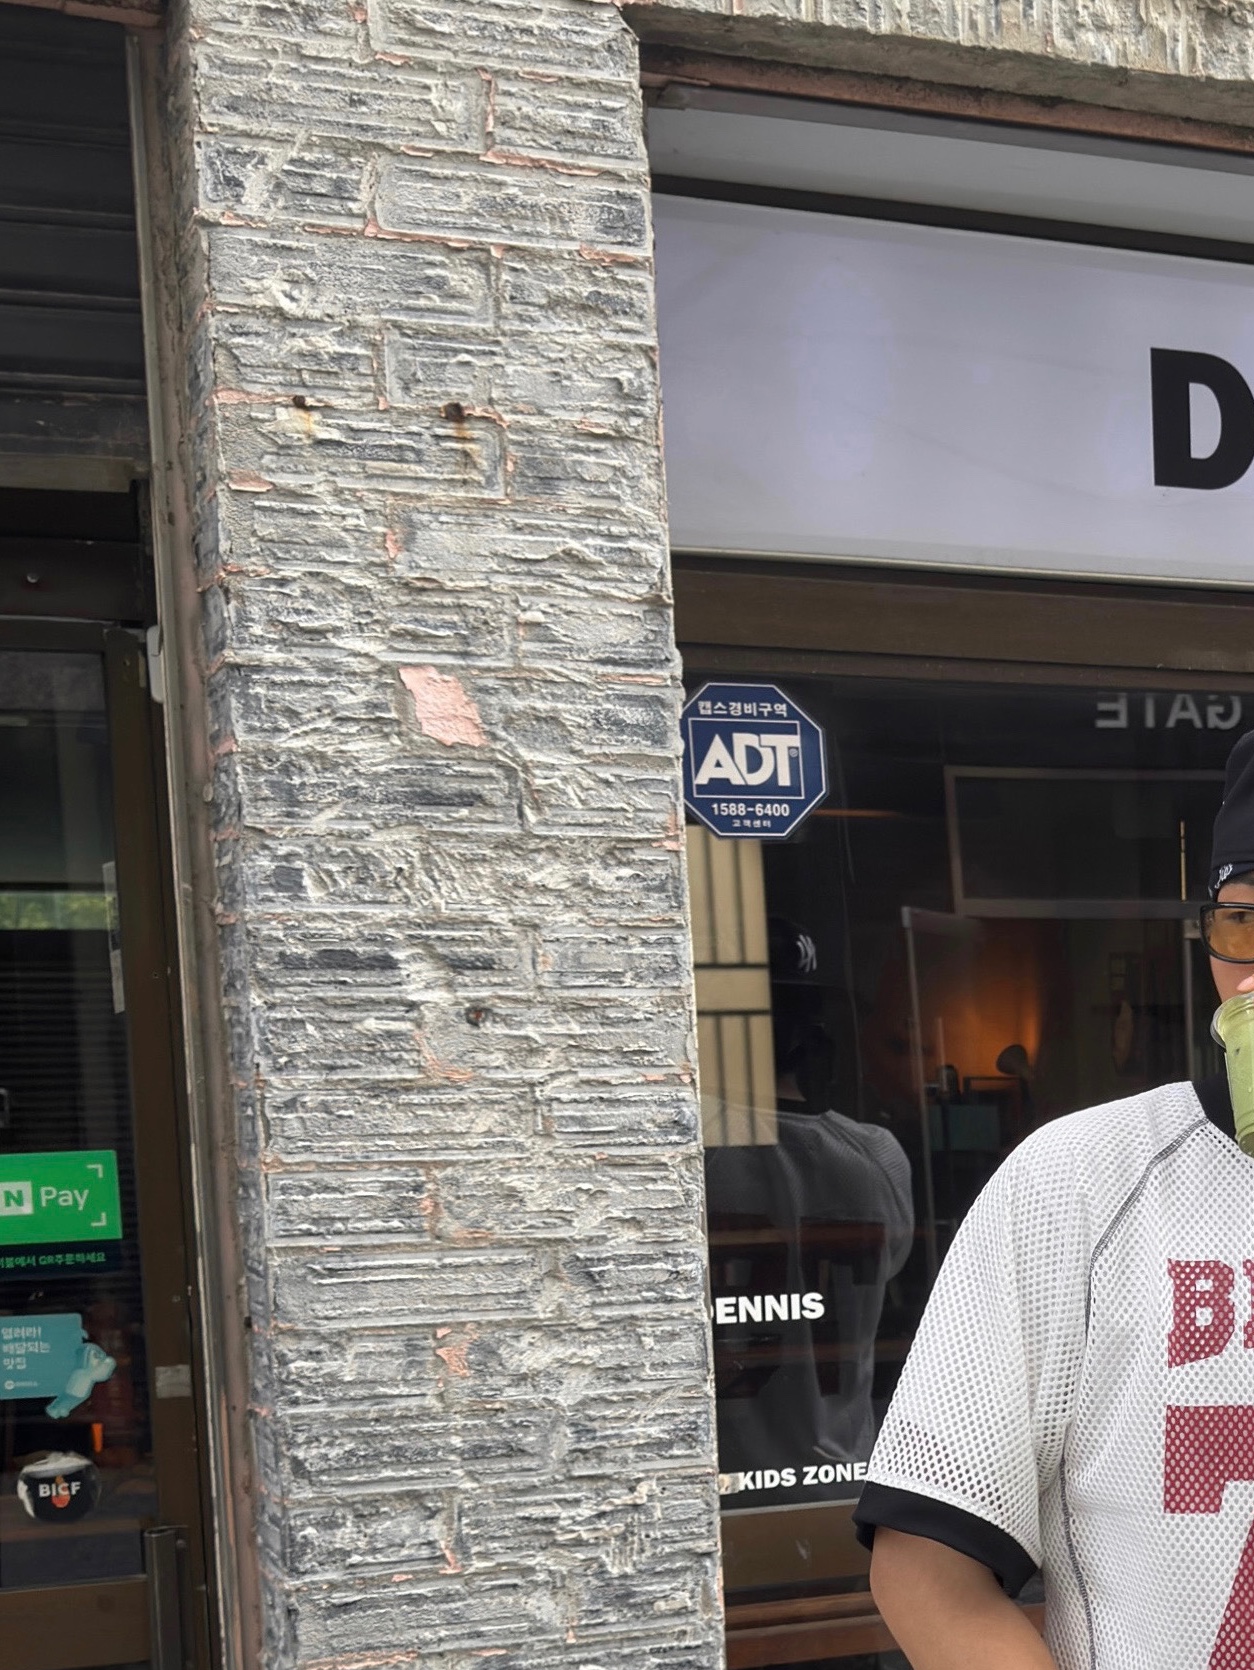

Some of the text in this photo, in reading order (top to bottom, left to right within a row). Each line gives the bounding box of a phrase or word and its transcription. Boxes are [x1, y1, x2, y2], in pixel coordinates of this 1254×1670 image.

[698, 700, 788, 717] 캡스경비구역
[694, 733, 800, 787] ADT
[711, 803, 790, 817] 1588-6400
[732, 819, 771, 828] 고객센터
[40, 1186, 90, 1211] Pay
[711, 1292, 825, 1324] ENNIS
[738, 1462, 867, 1490] KIDS ZONE
